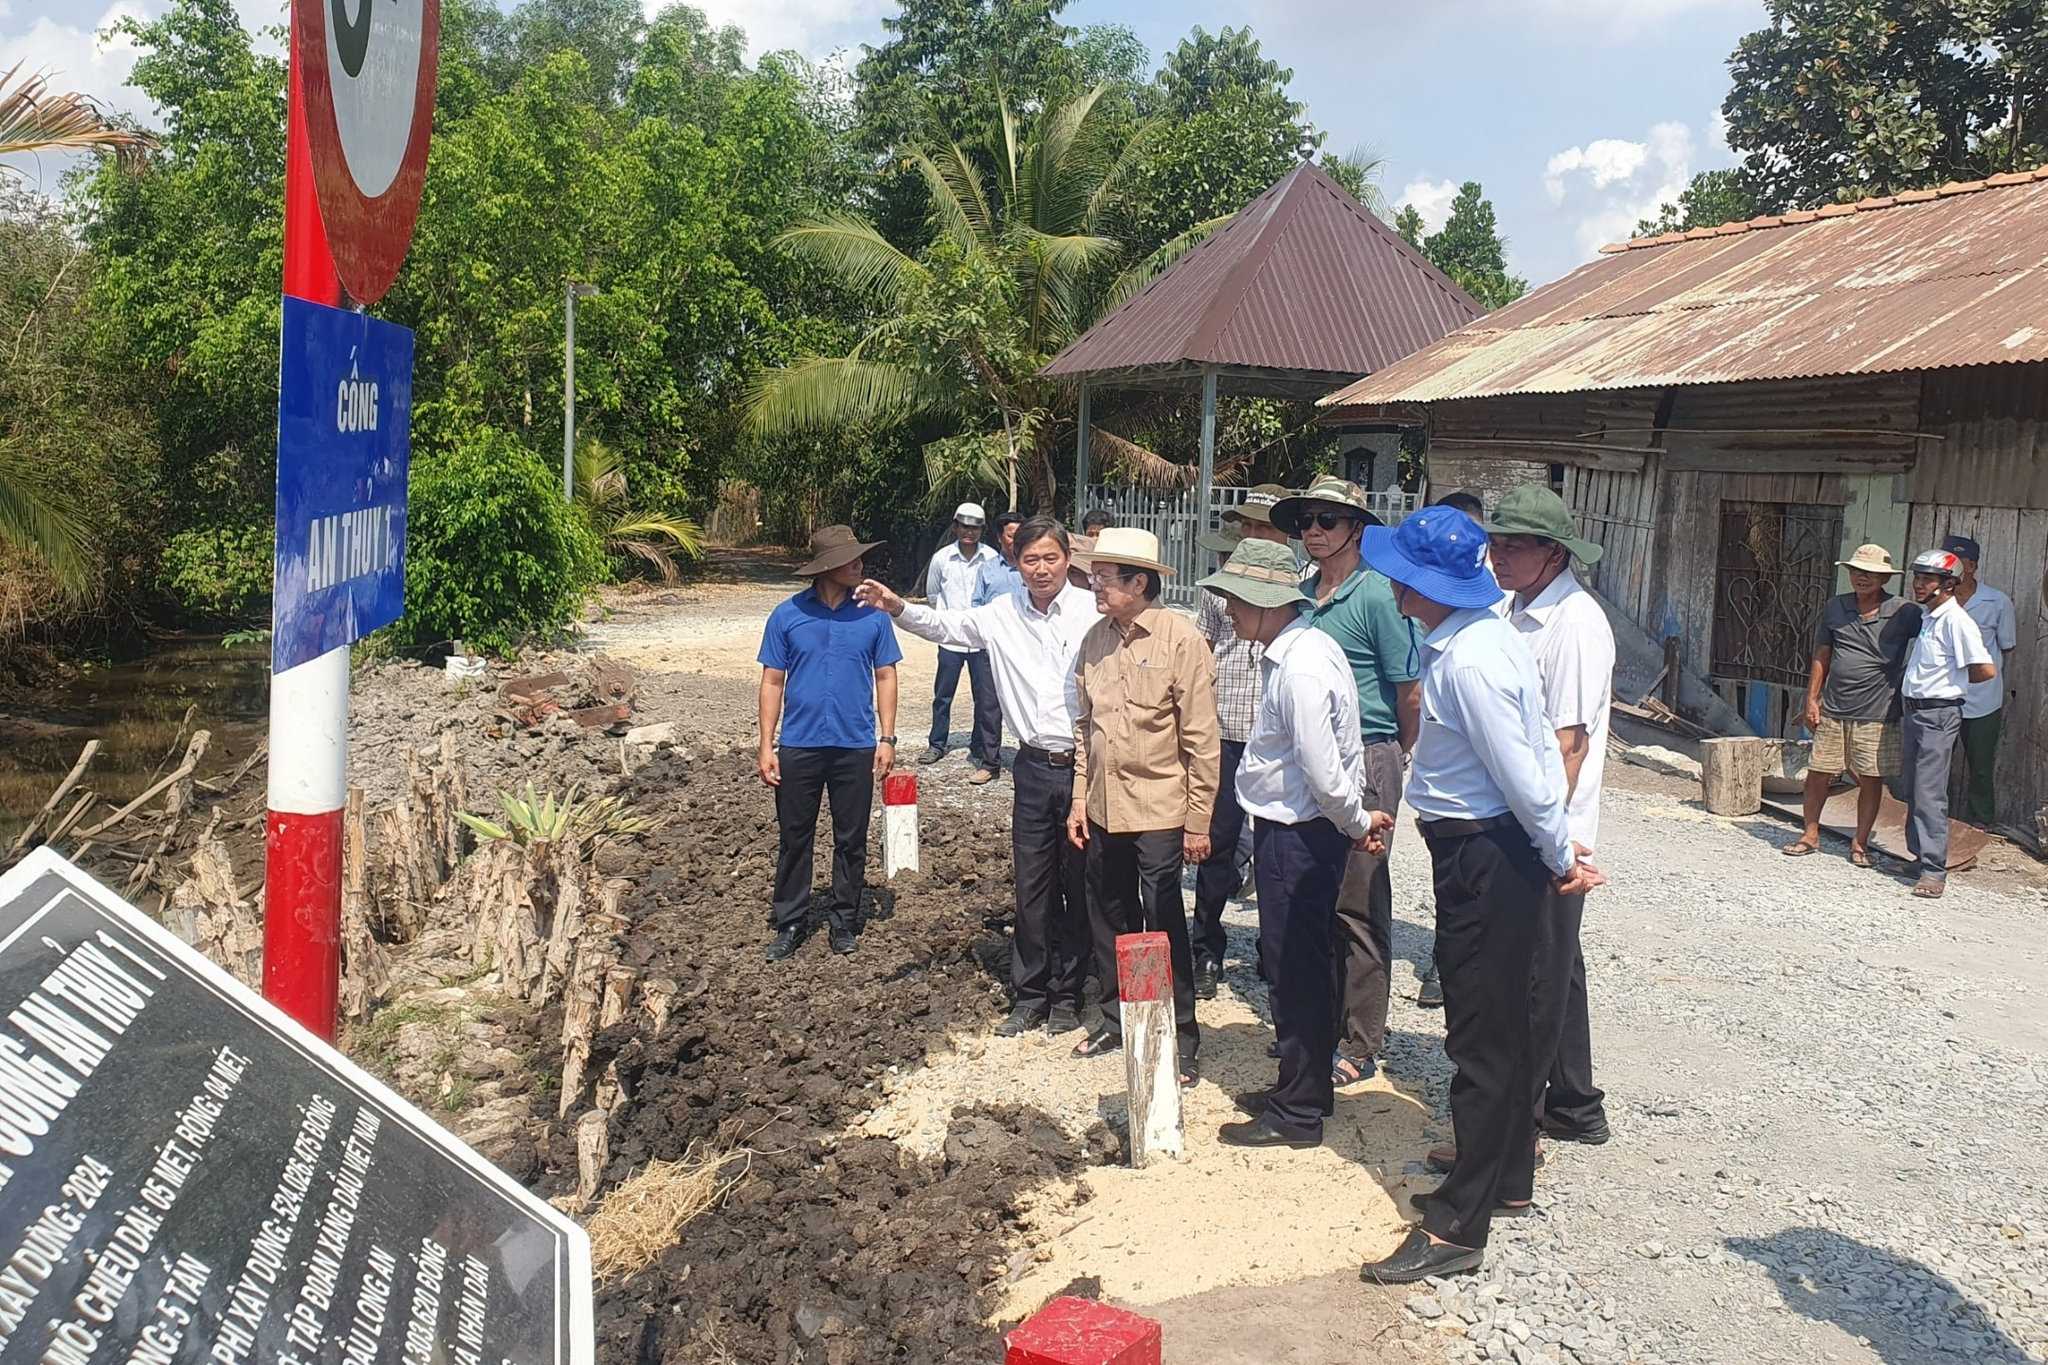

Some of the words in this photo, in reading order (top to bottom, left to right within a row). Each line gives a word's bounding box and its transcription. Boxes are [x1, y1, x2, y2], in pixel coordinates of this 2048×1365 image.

[337, 345, 378, 432] CỐNG
[307, 515, 337, 594] AN
[385, 504, 391, 566] 1
[7, 992, 114, 1077] AN
[95, 929, 167, 981] 1
[203, 1073, 233, 1100] 04
[212, 1045, 253, 1084] MÉT,
[175, 1095, 224, 1149] RỘNG:
[296, 1094, 336, 1141] ĐỒNG
[352, 1106, 381, 1145] NAM
[152, 1139, 203, 1188] MÉT,
[270, 1131, 322, 1222] 524.026.475
[340, 1135, 375, 1175] VIỆT
[140, 1177, 177, 1211] 05
[326, 1167, 364, 1210] DẦU
[13, 1202, 87, 1280] DỰNG:
[61, 1154, 114, 1210] 2024
[114, 1205, 164, 1254] DÀI:
[314, 1202, 354, 1260] XĂNG
[245, 1218, 293, 1284] DỰNG:
[368, 1244, 396, 1282] AN
[408, 1237, 447, 1294] ĐỒNG
[458, 1254, 490, 1299] DÂN
[75, 1241, 141, 1322] CHIỀU
[160, 1251, 212, 1305] TẤN
[226, 1273, 270, 1331] XÂY
[301, 1249, 341, 1311] ĐOÀN
[156, 1297, 191, 1325] 5
[283, 1302, 328, 1354] TẬP
[353, 1273, 391, 1337] LONG
[454, 1291, 487, 1352] NHÂN
[126, 1320, 183, 1365] NG:
[211, 1312, 255, 1365] PHÍ
